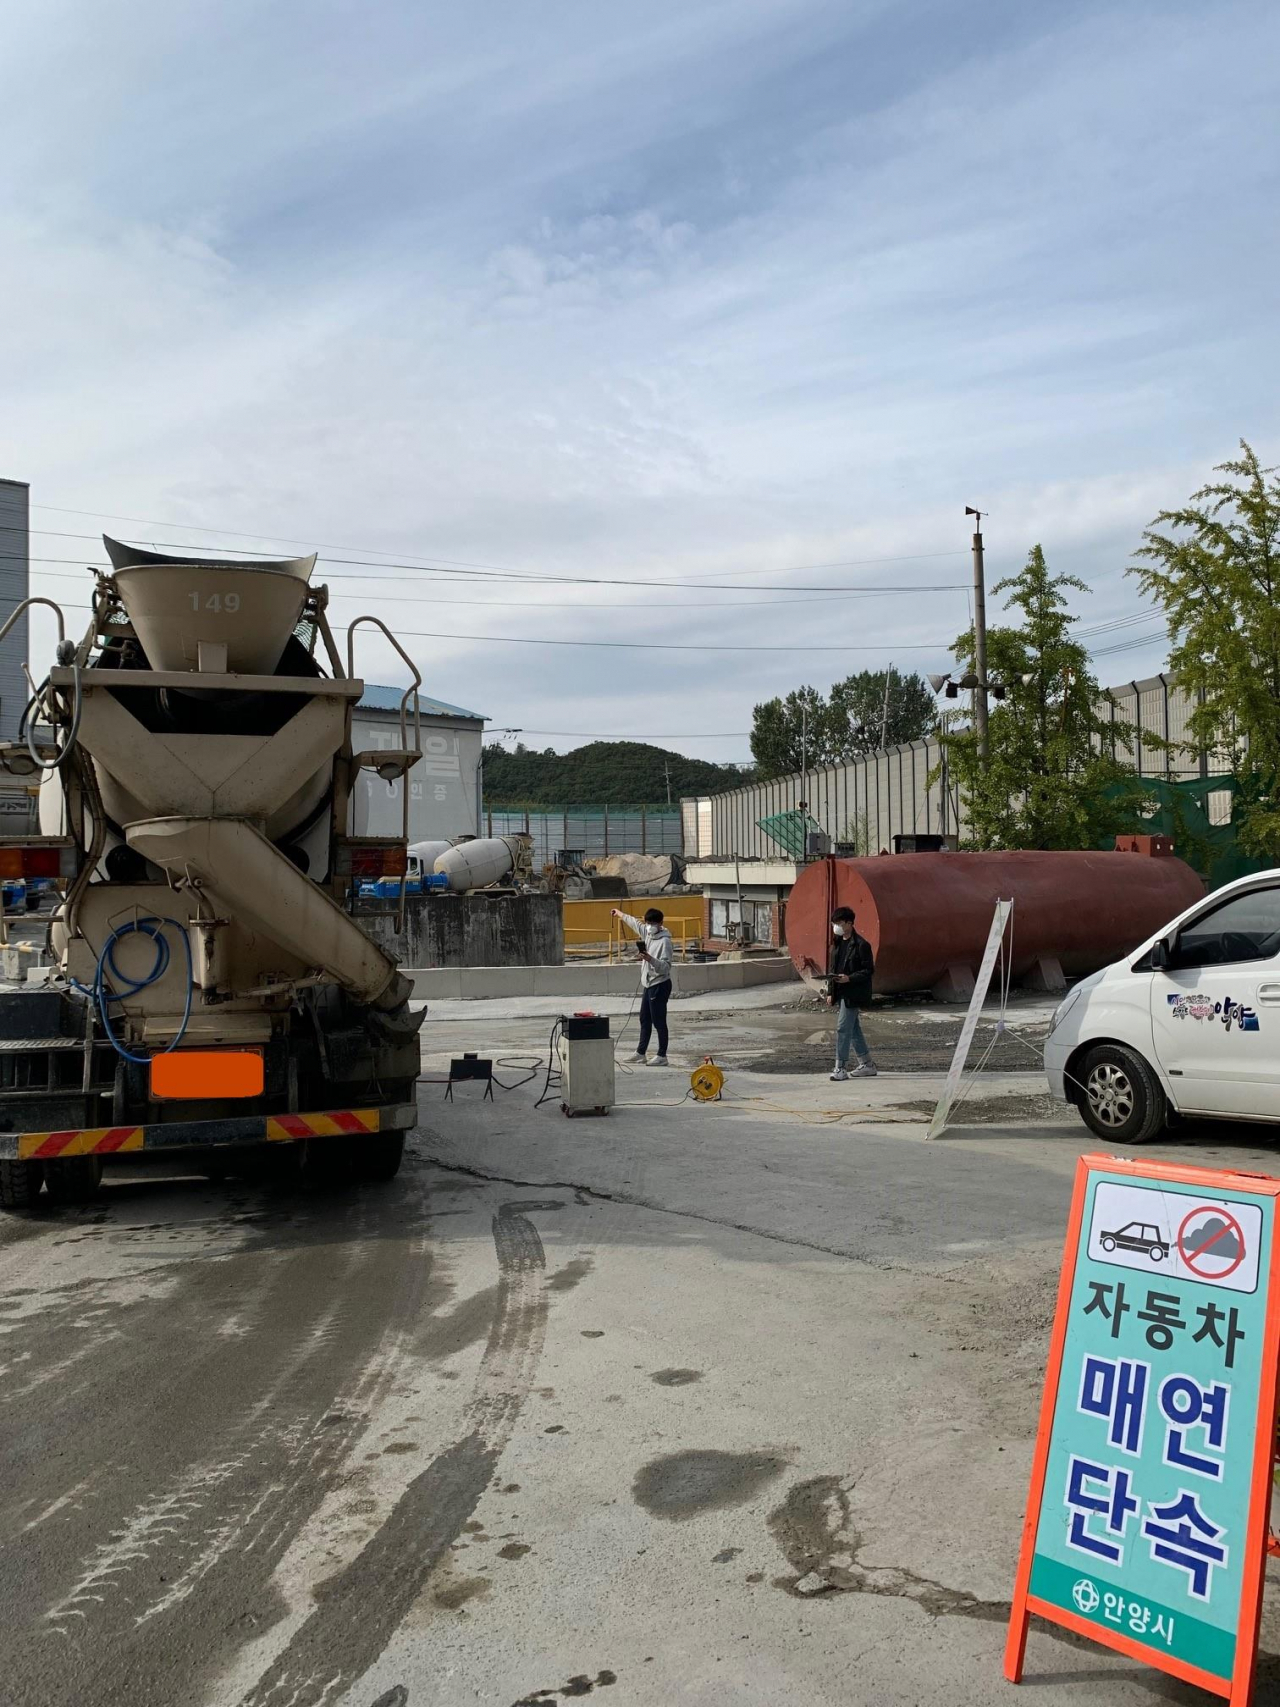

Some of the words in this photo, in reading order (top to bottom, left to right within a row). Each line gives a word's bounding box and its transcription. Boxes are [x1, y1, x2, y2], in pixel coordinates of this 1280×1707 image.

[188, 591, 240, 613] 149
[1214, 996, 1256, 1029] 안양
[1083, 1279, 1246, 1368] 자동차
[1077, 1353, 1231, 1482] 매연
[1064, 1453, 1229, 1603] 단속
[1102, 1590, 1175, 1645] 안양시
